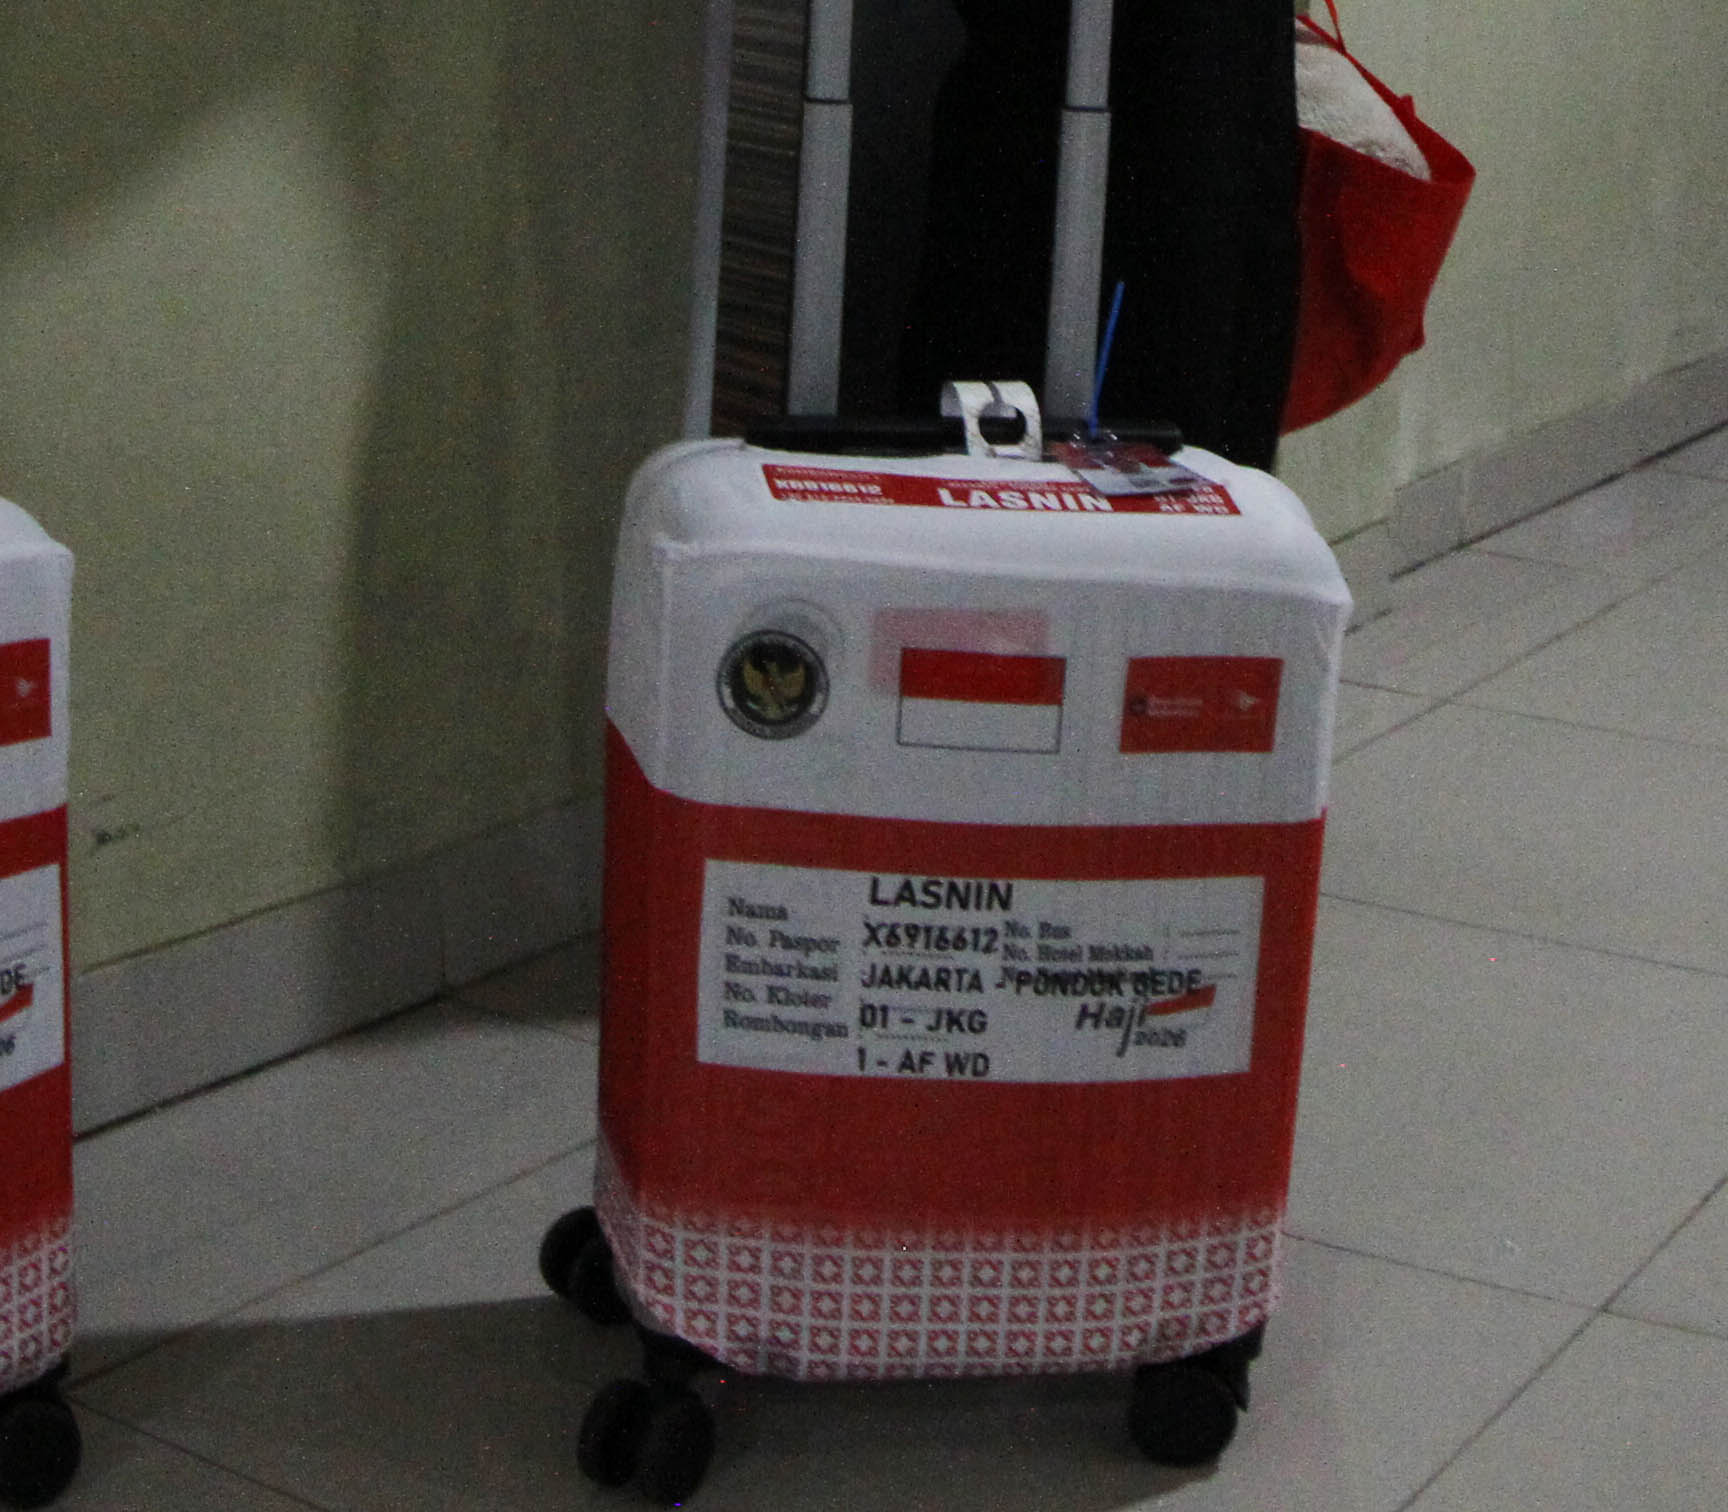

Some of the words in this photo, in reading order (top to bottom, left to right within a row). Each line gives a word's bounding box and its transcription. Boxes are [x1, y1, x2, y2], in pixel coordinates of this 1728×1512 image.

[937, 487, 1115, 512] LASNIN
[870, 876, 1013, 912] LASNIN
[728, 898, 788, 921] Nama
[769, 930, 840, 957] Paspor
[863, 922, 1000, 954] X6916612
[725, 953, 839, 983] Embarkasi
[862, 963, 984, 993] JAKARTA
[1015, 968, 1124, 997] PONDOK
[766, 985, 831, 1009] Kloter
[723, 1009, 849, 1041] Rombongan
[860, 1004, 889, 1029] 01
[926, 1009, 988, 1034] JKG
[1075, 998, 1149, 1058] Haji
[897, 1050, 935, 1074] AF
[945, 1053, 990, 1078] WD
